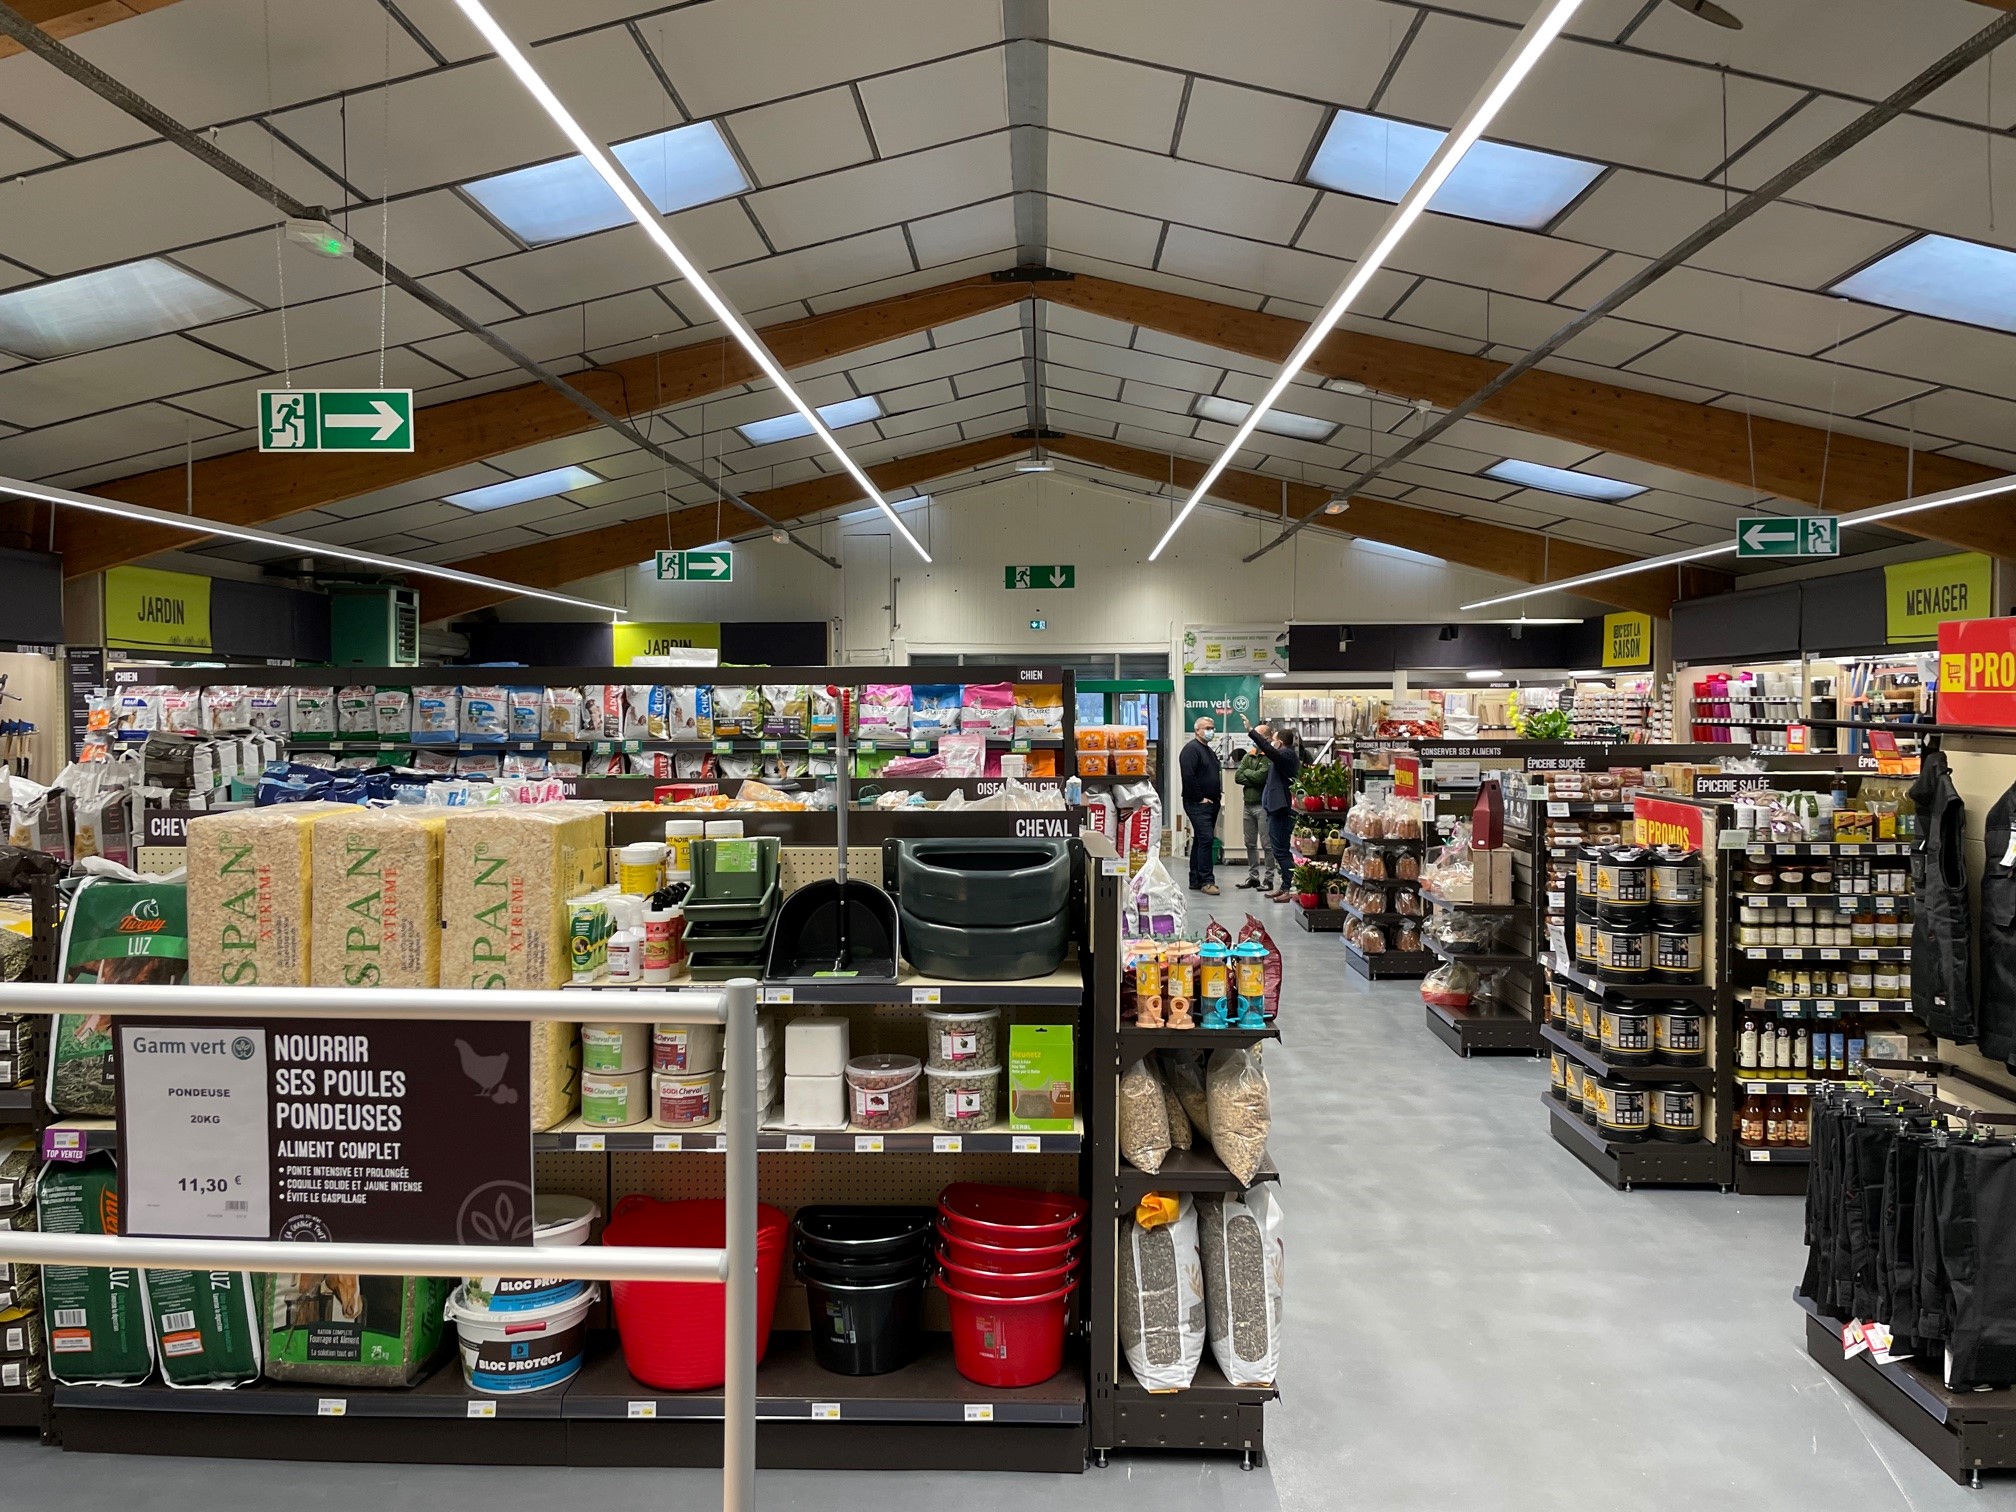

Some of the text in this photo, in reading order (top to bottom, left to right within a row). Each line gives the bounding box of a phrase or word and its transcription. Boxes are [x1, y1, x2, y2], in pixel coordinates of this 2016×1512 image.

[1906, 583, 1968, 617] MENAGER
[137, 595, 185, 626] JARDIN
[1618, 622, 1641, 638] C'EST LA
[643, 639, 692, 655] JARDIN
[1613, 637, 1641, 659] SAISON
[115, 671, 138, 682] CHIEN
[1020, 670, 1043, 681] CHIEN
[1969, 651, 2016, 688] PRO
[1210, 700, 1231, 709] vert
[1421, 748, 1502, 756] CONSERVER SES ALIMENTS
[1527, 756, 1586, 770] ÉPICERIE SUCRÉE
[977, 782, 1007, 796] OISEA
[1696, 776, 1770, 793] ÉPICERIE SALÉE
[1015, 818, 1073, 838] CHEVAL
[1138, 810, 1150, 846] ADULTE
[1647, 819, 1690, 851] PROMOS
[257, 863, 272, 940] XTREME
[383, 867, 397, 942] XTREME
[510, 876, 524, 952] XTREME
[118, 914, 169, 933] Twenty
[128, 936, 153, 956] LUZ
[133, 1036, 227, 1055] Gamm vert
[274, 1033, 369, 1063] NOURRIR
[275, 1069, 406, 1098] SES POULES
[678, 1086, 702, 1095] Cheval
[168, 1088, 231, 1098] PONDEUSE
[190, 1114, 221, 1124] 20KG
[276, 1102, 403, 1132] PONDEUSES
[46, 1150, 84, 1159] TOP VENTES
[278, 1140, 402, 1161] ALIMENT COMPLET
[286, 1166, 410, 1178] PONTE INTENSIVE ET PROLONGÉE
[178, 1174, 242, 1195] 11,30 €
[286, 1179, 424, 1192] COQUILLE SOLIDE ET JAUNE INTENSE
[286, 1190, 368, 1204] ÉVITE LE GASPILLAGE
[109, 1267, 130, 1290] UZ
[210, 1270, 231, 1290] UZ
[500, 1281, 532, 1292] BLOC
[309, 1335, 360, 1345] Fourrage et Aliment
[311, 1349, 316, 1357] La
[318, 1349, 336, 1358] solution
[336, 1350, 346, 1358] tout
[478, 1359, 506, 1372] BLOC
